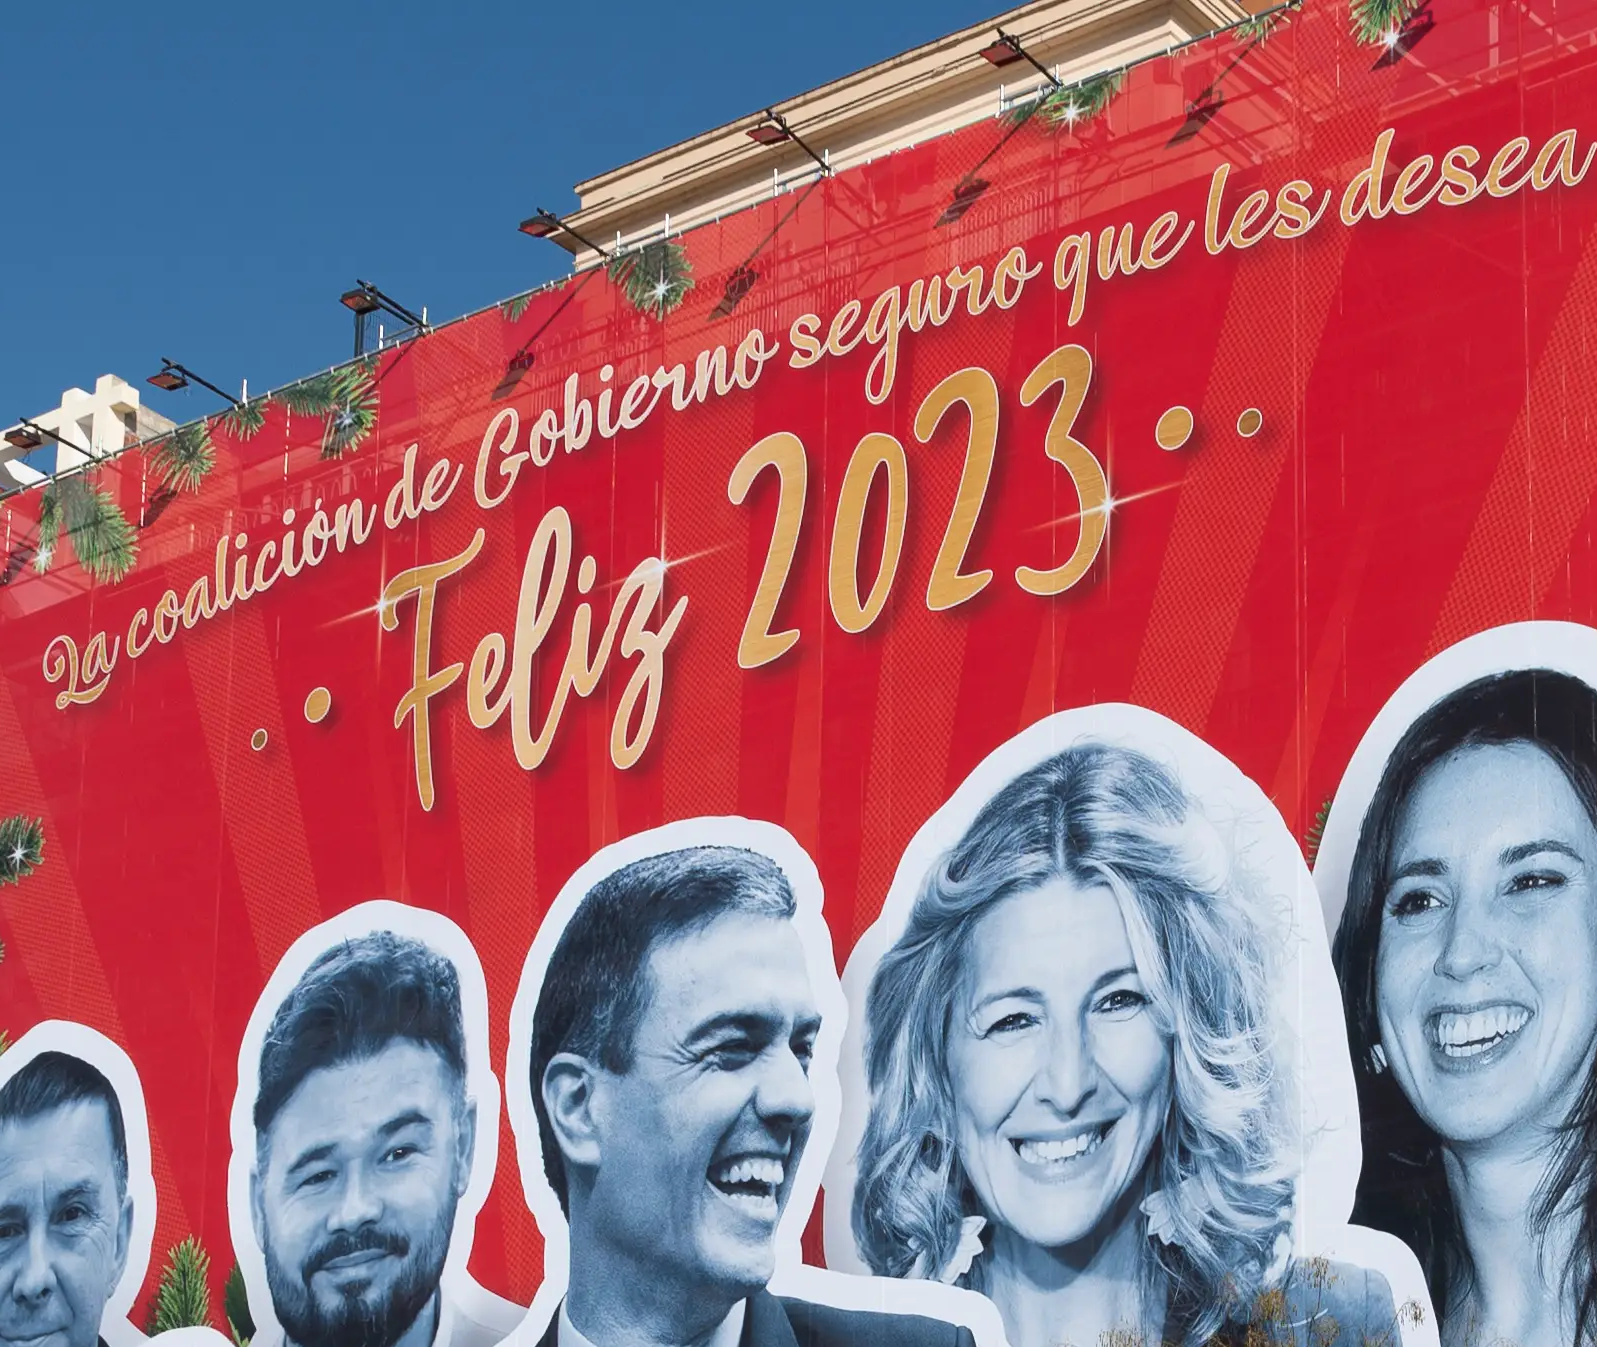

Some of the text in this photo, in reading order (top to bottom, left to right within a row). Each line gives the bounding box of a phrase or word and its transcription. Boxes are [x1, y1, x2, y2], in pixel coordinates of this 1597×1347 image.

[42, 631, 120, 710] La
[125, 497, 382, 655] coalición
[383, 442, 465, 530] de
[472, 329, 780, 510] Gobierno
[788, 245, 1044, 405] seguro
[1053, 210, 1196, 327] que
[1204, 161, 1332, 256] les
[380, 344, 1111, 812] Feliz 2023
